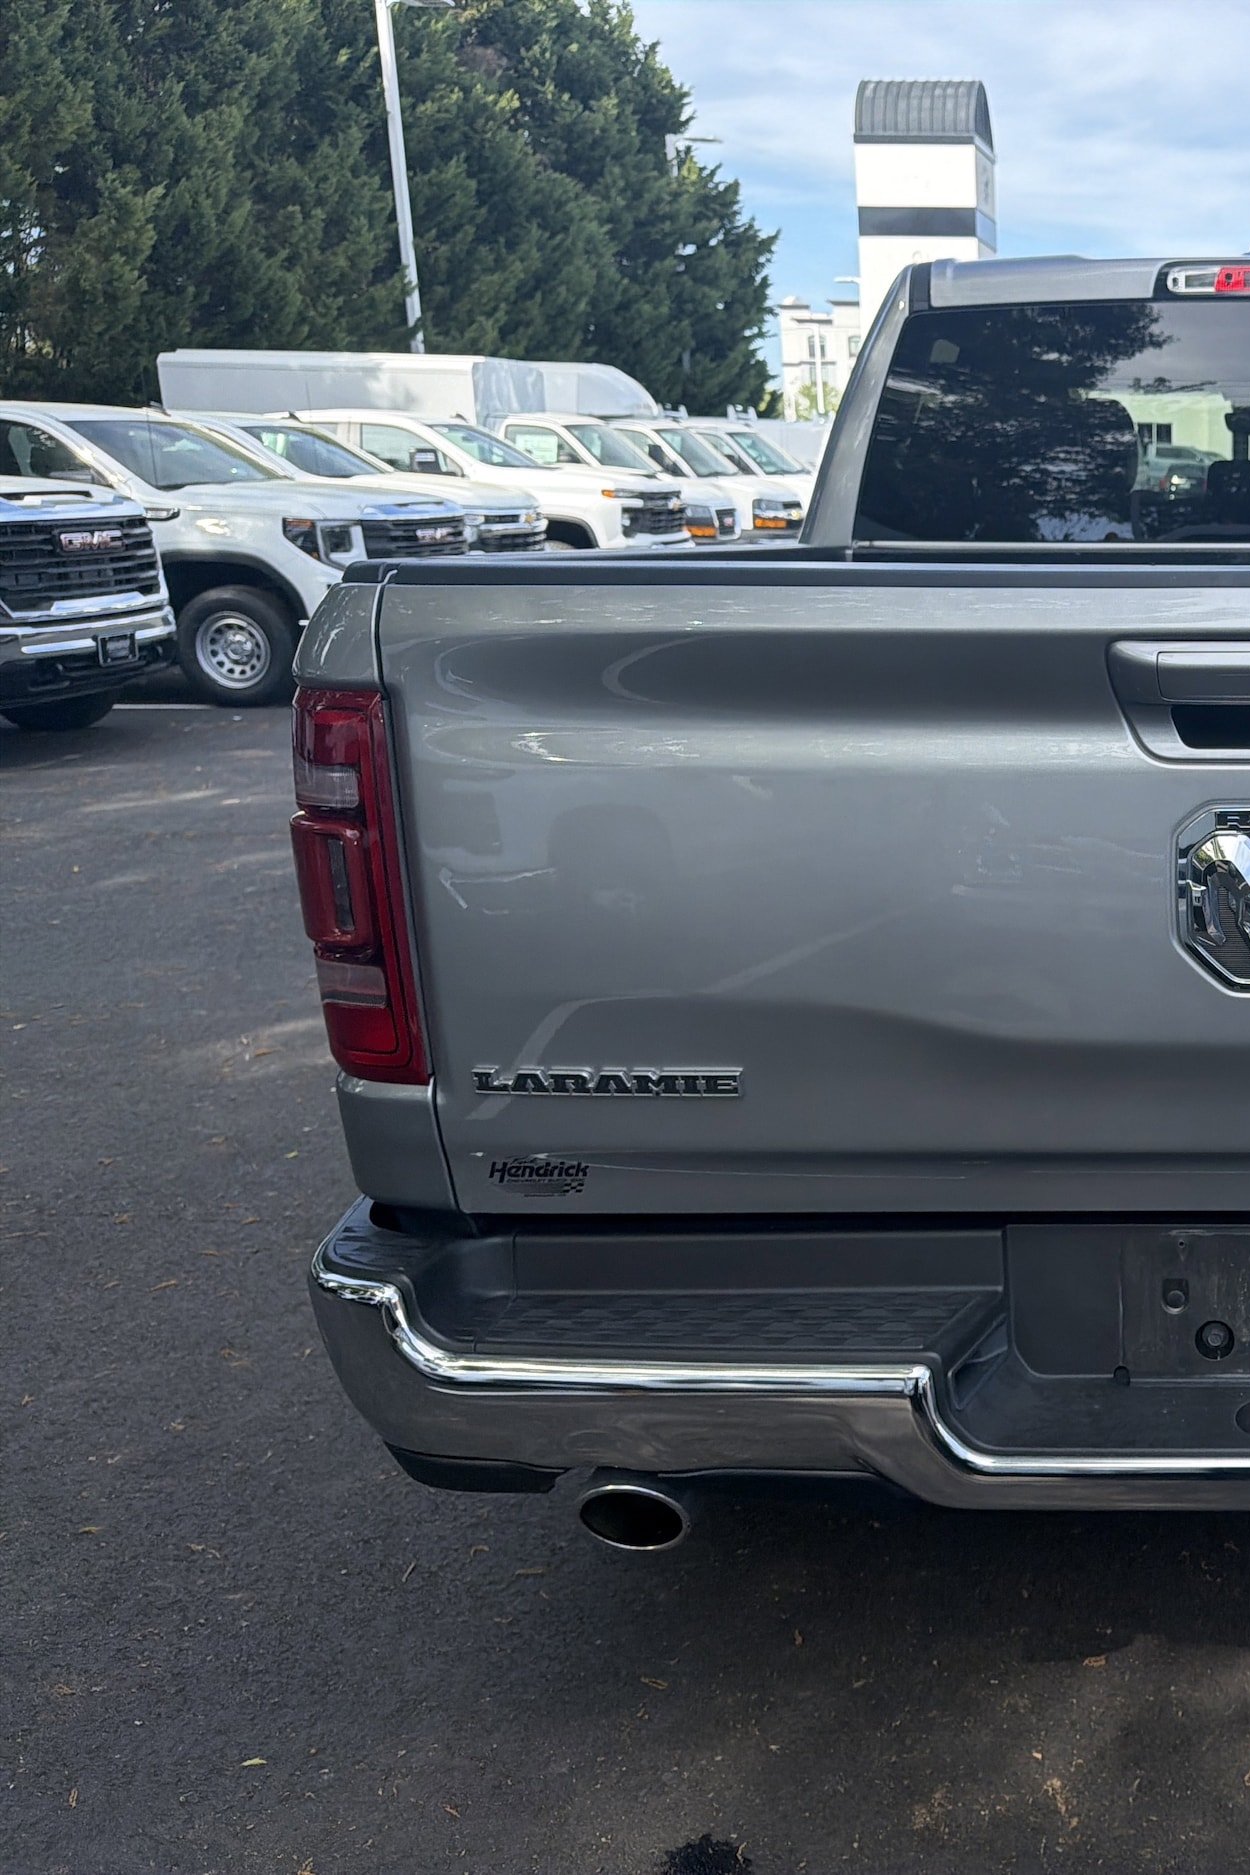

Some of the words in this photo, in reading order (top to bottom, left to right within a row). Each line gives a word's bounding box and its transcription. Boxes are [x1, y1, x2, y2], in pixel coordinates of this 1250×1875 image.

[60, 530, 122, 551] GMC
[471, 1066, 743, 1097] LARAMIE
[489, 1161, 589, 1183] Hendrick
